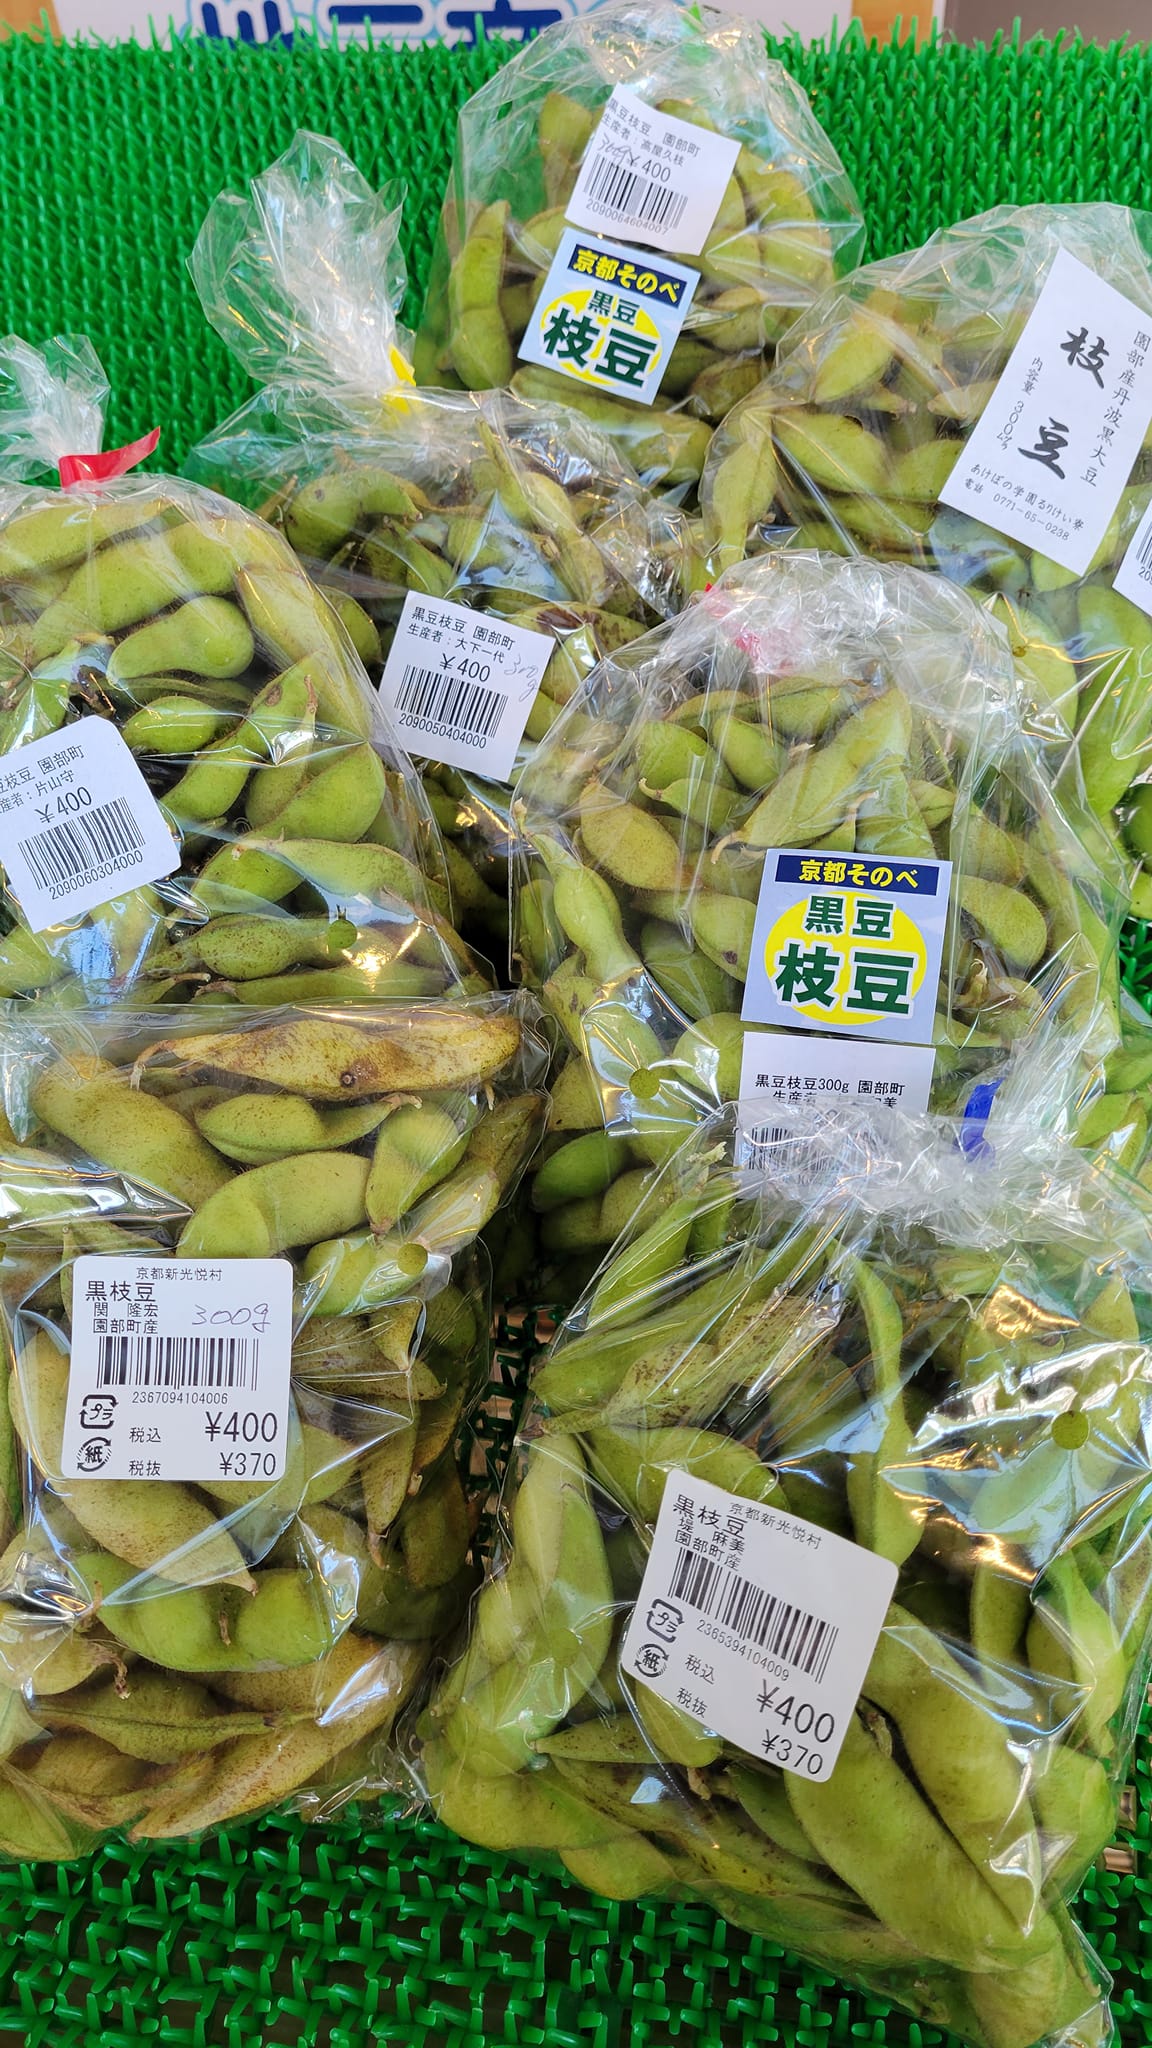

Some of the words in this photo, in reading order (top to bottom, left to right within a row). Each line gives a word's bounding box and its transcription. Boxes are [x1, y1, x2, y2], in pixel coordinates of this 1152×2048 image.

[607, 97, 652, 137] 黒豆枝豆
[662, 132, 701, 158] 園部町
[585, 198, 669, 236] 2090064604007
[572, 248, 680, 303] 京都そのべ
[588, 289, 641, 326] 黒豆
[543, 307, 657, 388] 枝豆
[1017, 326, 1110, 480] 枝豆
[1080, 331, 1151, 487] 園部産丹波黒大豆
[411, 606, 468, 635] 黒豆枝豆
[472, 625, 516, 651] 園部町
[439, 653, 491, 682] ¥400
[398, 712, 487, 749] 2090050404000
[37, 745, 84, 775] 園部町
[34, 786, 92, 823] ¥400
[49, 849, 143, 900] 2090060304000
[798, 859, 919, 888] 京都そのべ
[805, 895, 894, 939] 黒豆
[775, 943, 914, 1015] 枝豆
[755, 1073, 850, 1093] 黒豆枝豆300g
[858, 1079, 906, 1096] 園部町
[85, 1280, 157, 1302] 黒枝豆
[136, 1267, 223, 1282] 京都新光悦村
[93, 1302, 109, 1317] 関
[128, 1302, 158, 1318] 隆宏
[93, 1318, 159, 1334] 園部町産
[191, 1302, 271, 1334] 300g
[89, 1403, 114, 1421] プラ
[131, 1391, 229, 1405] 2367094104006
[128, 1427, 162, 1443] 税込
[204, 1411, 278, 1443] ¥400
[84, 1444, 104, 1464] 紙
[128, 1460, 161, 1477] 税抜
[219, 1452, 277, 1477] ¥370
[672, 1494, 748, 1540] 黒枝豆
[730, 1502, 822, 1550] 京都新光悦村
[675, 1529, 742, 1572] 園部町産
[711, 1530, 745, 1556] 麻美
[643, 1650, 661, 1673] 紙
[696, 1619, 790, 1682] 2365394104009
[684, 1653, 716, 1685] 税込
[756, 1678, 835, 1743] ¥400
[676, 1687, 708, 1719] 税抜
[761, 1728, 823, 1775] ¥370
